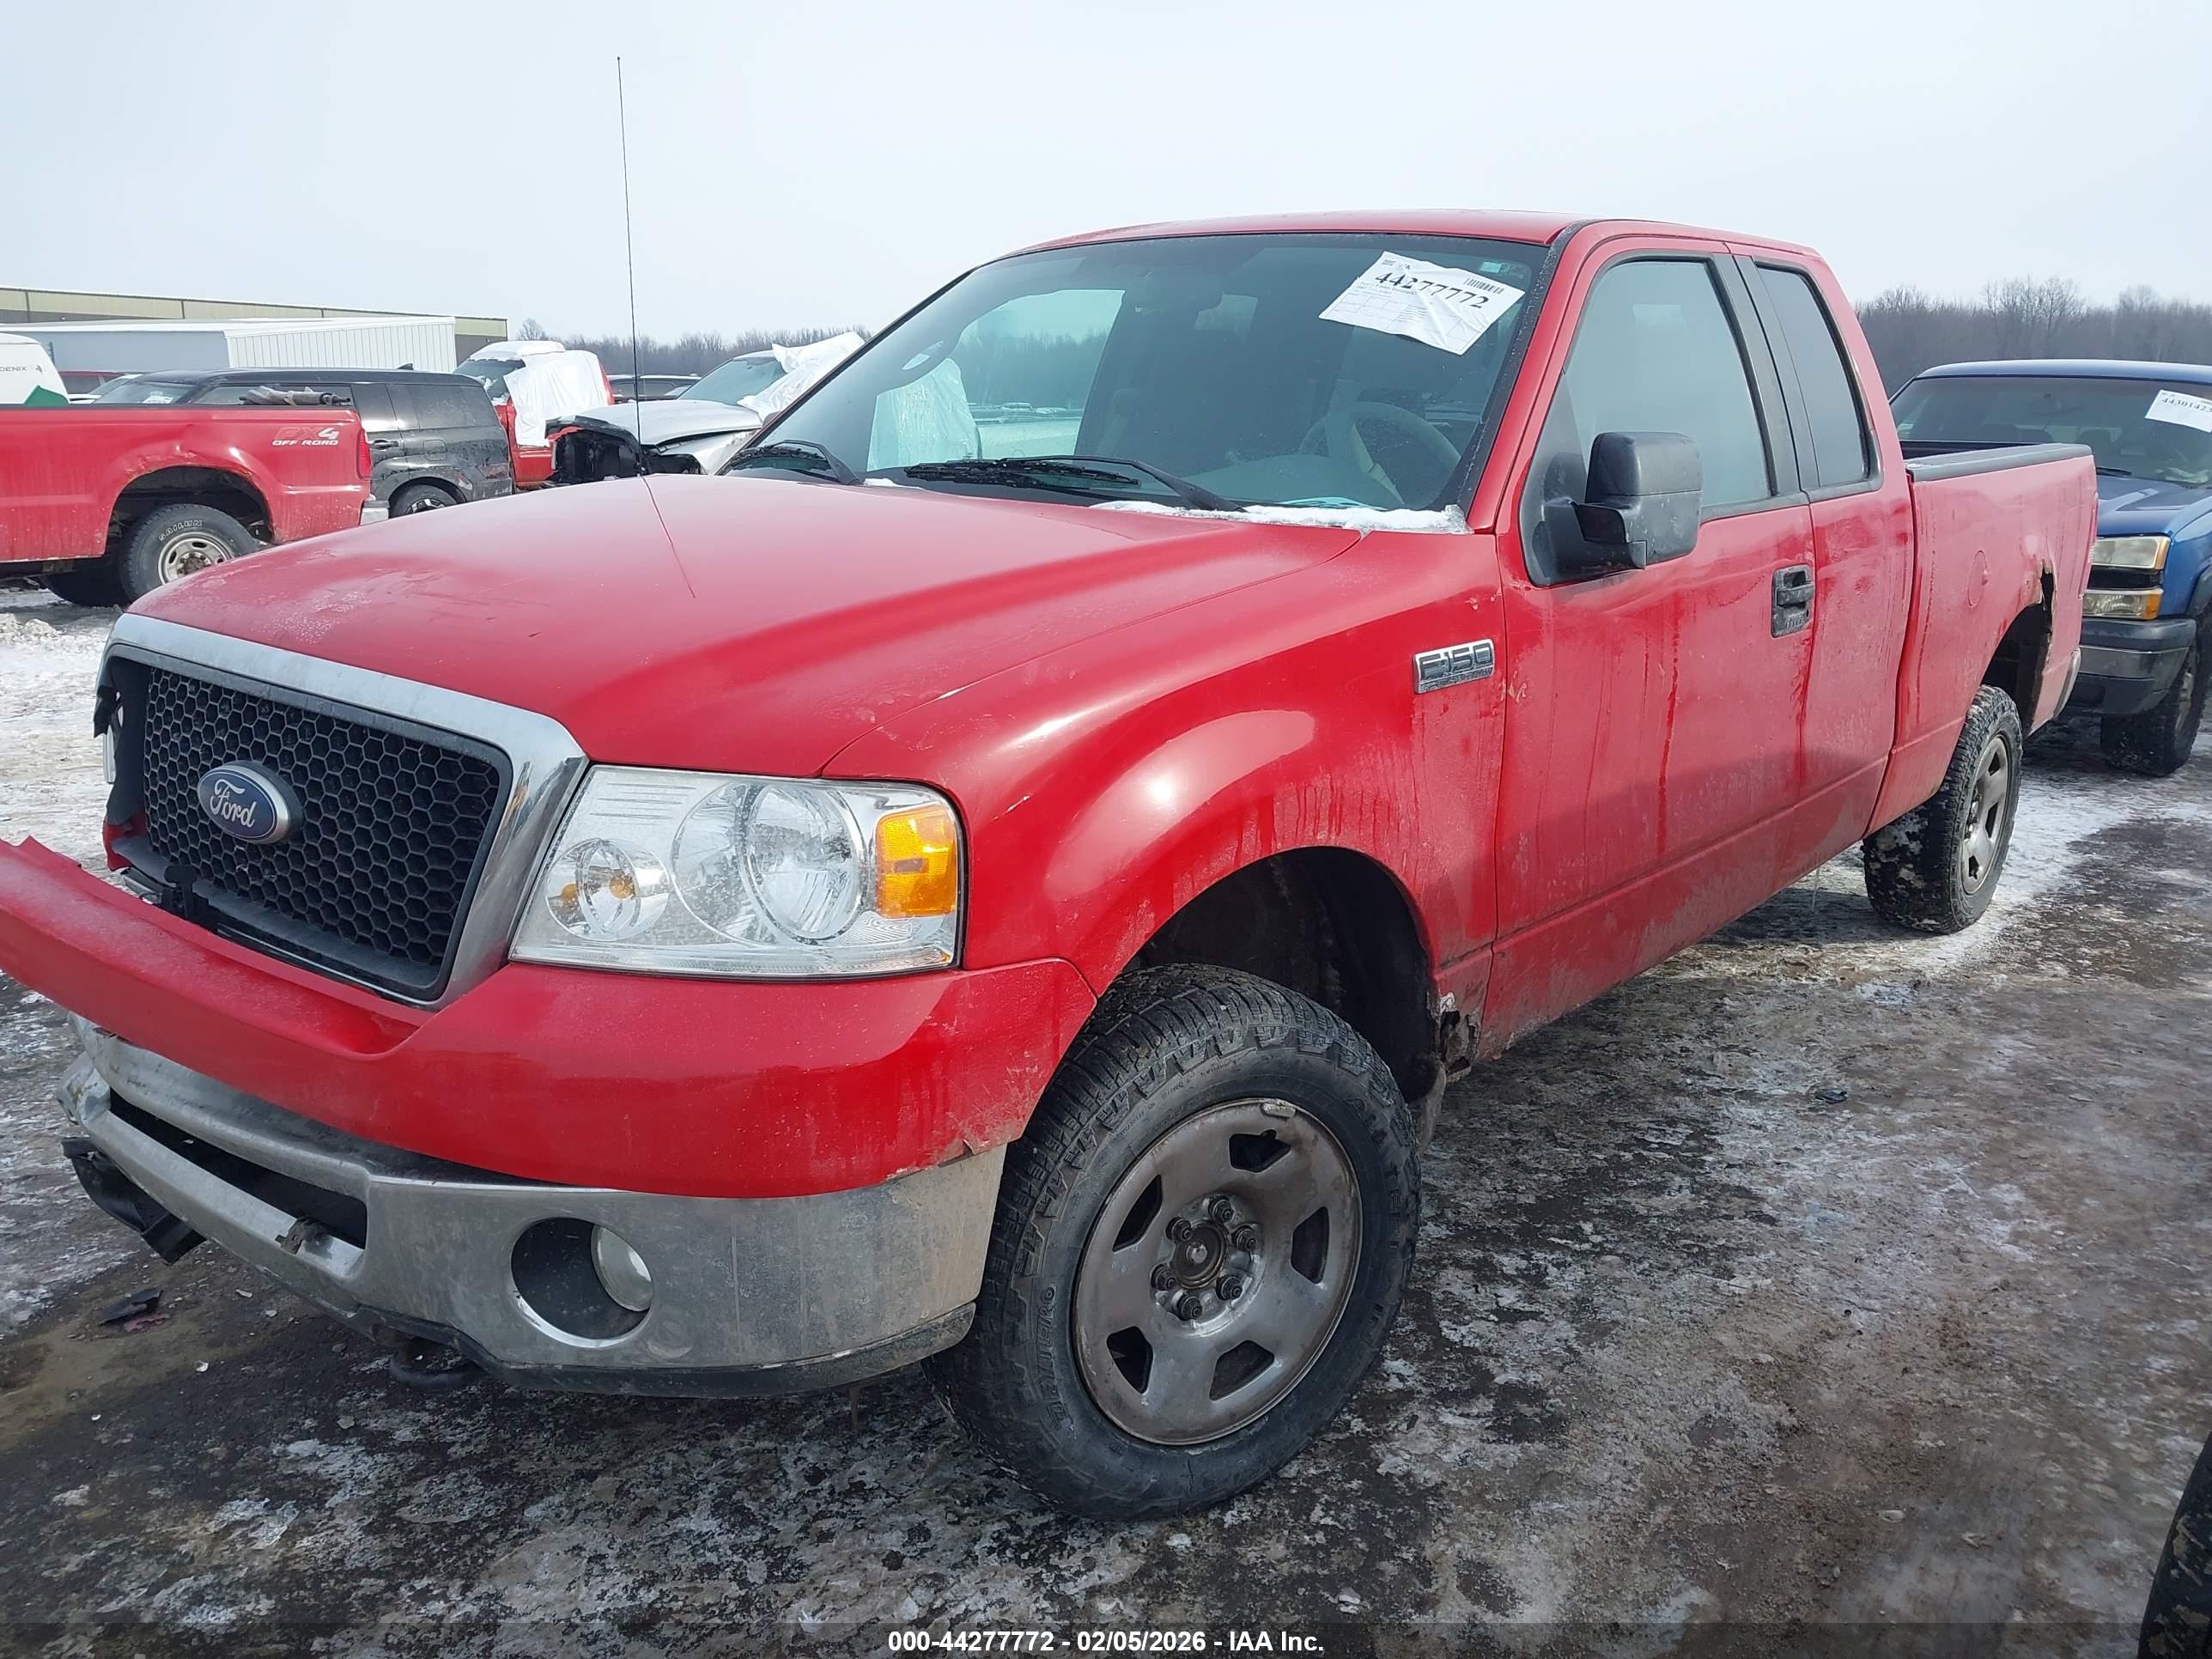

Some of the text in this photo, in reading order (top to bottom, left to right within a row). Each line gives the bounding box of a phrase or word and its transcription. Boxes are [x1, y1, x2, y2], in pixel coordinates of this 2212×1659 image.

[1375, 272, 1489, 309] 44277772
[158, 520, 203, 542] SAILUN
[210, 778, 258, 828] Ford
